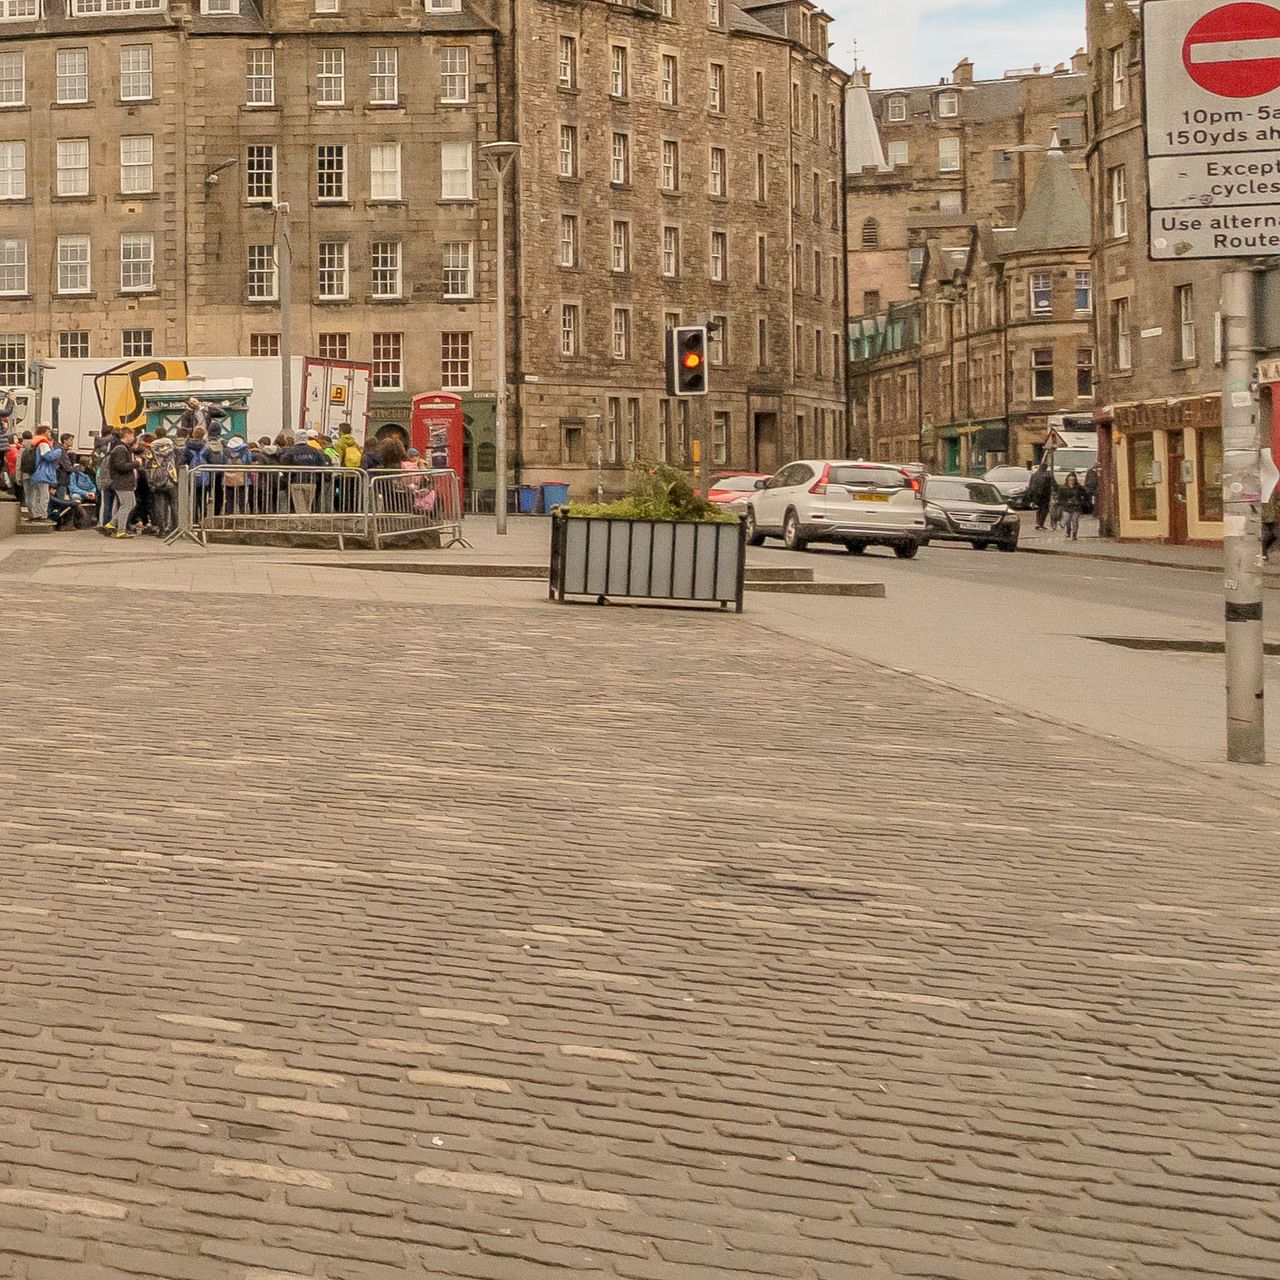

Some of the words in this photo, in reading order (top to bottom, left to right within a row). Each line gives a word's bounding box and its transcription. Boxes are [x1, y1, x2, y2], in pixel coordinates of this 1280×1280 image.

[1166, 128, 1248, 146] 150yds
[1211, 180, 1280, 198] cycles
[1161, 216, 1202, 231] Use
